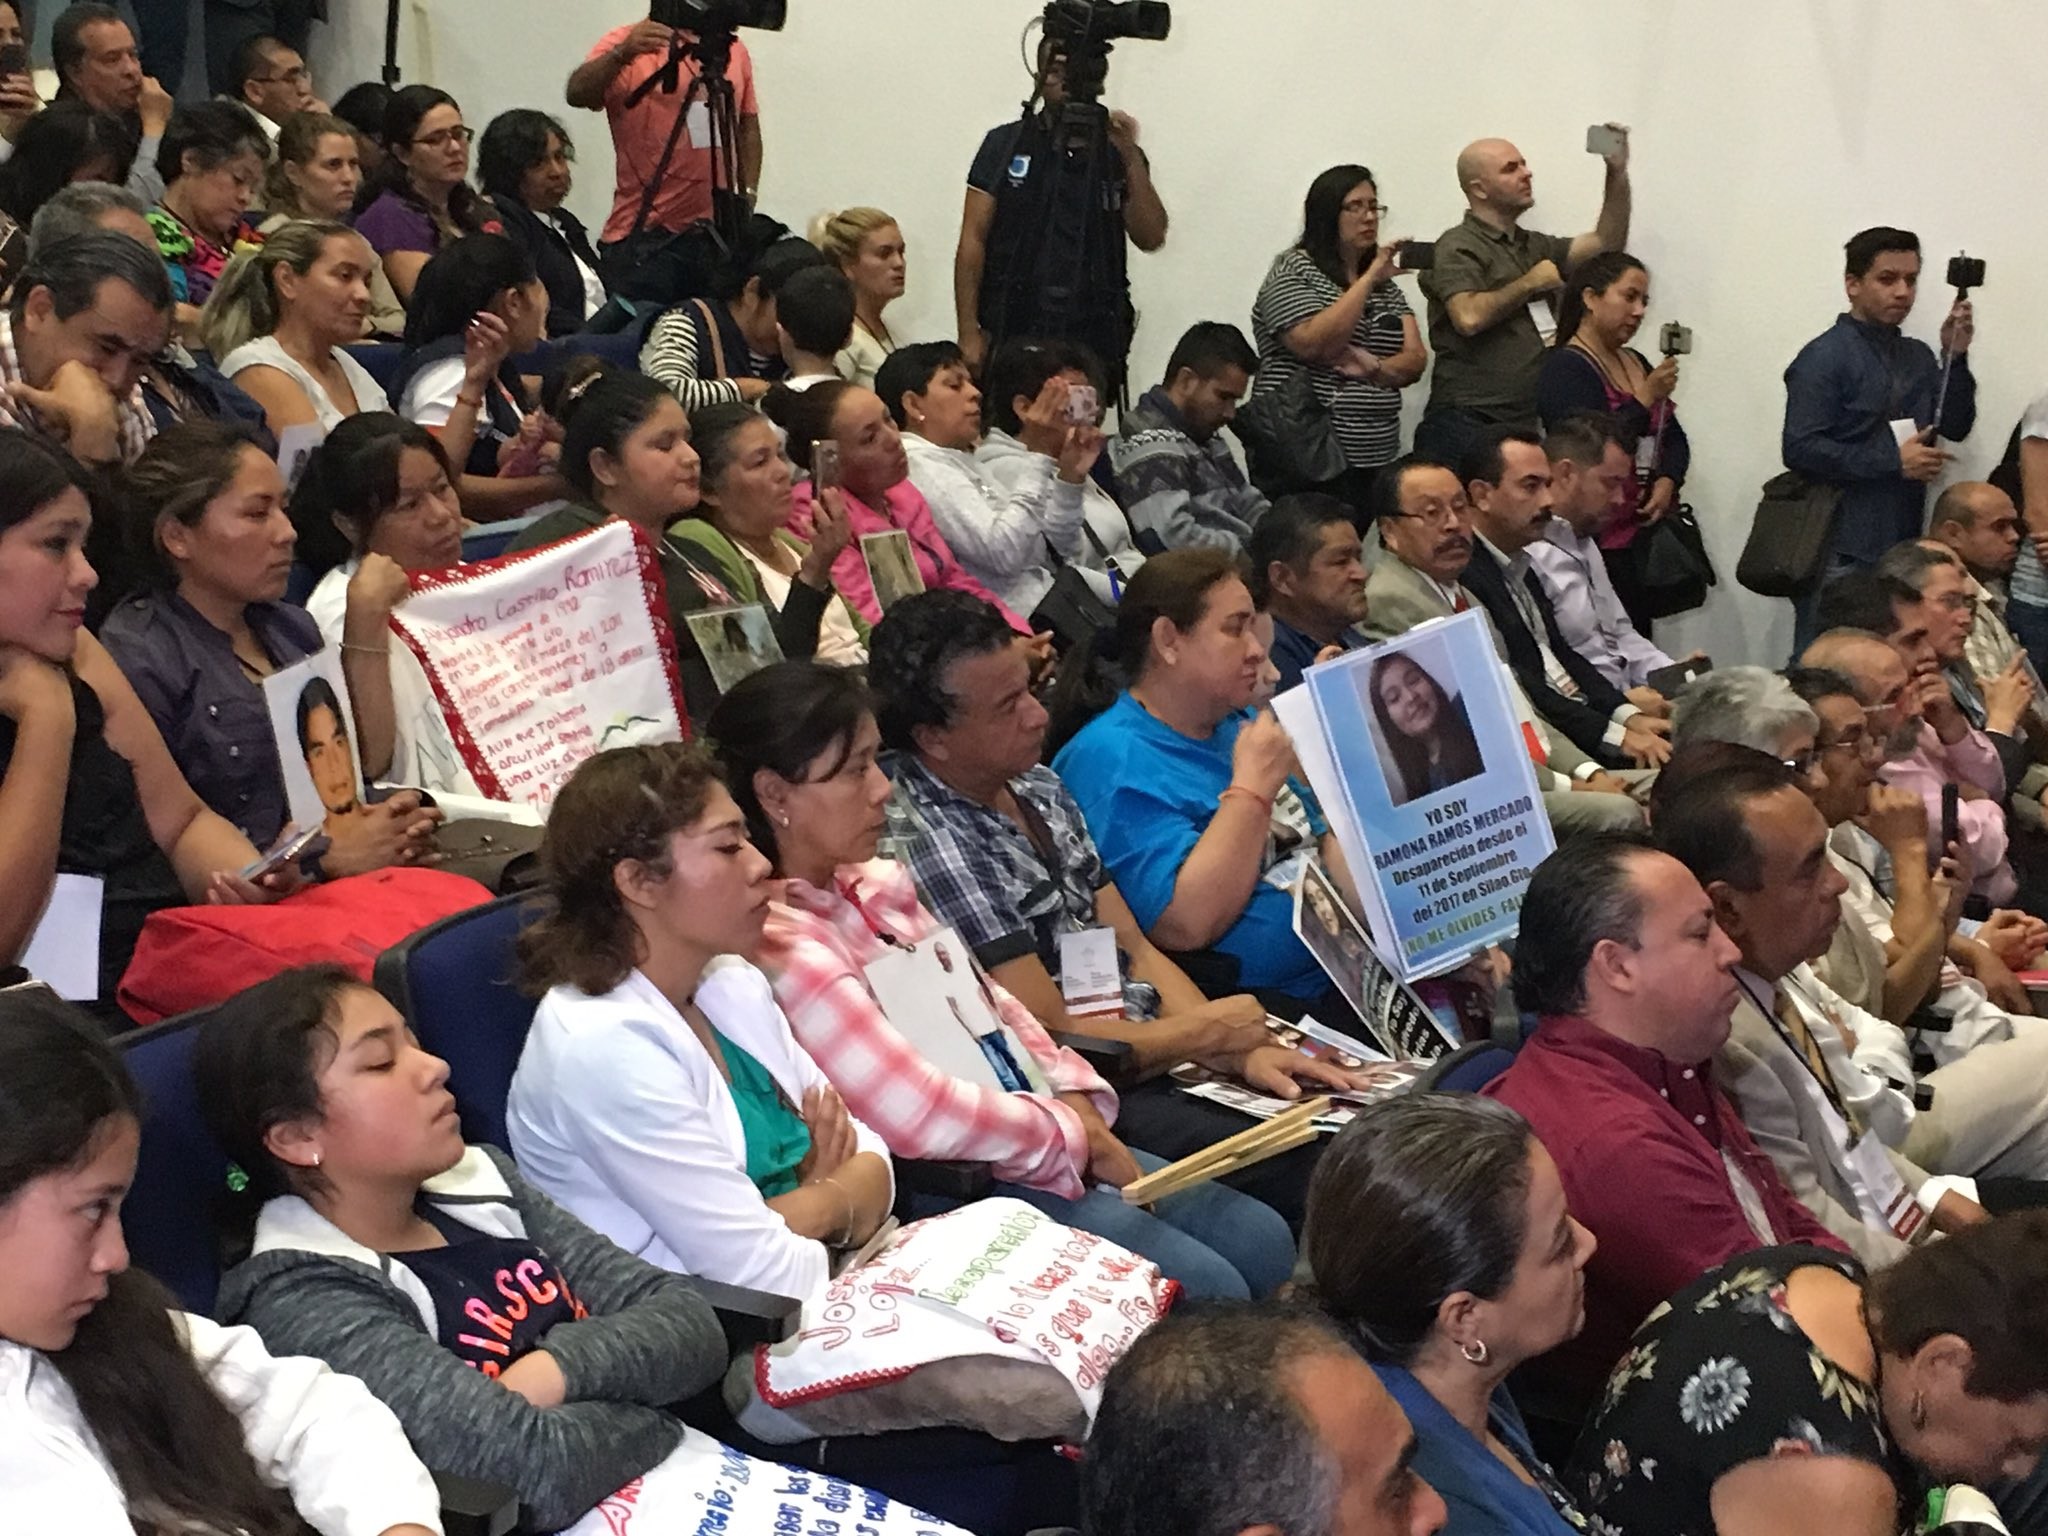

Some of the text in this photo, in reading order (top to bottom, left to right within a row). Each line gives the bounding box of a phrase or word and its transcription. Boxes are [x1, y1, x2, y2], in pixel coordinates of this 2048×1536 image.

[1374, 796, 1534, 871] RAMONA RAMOS MERCADO
[1425, 798, 1469, 827] YO SOY
[1392, 821, 1529, 887] Desaparecida desde el
[1431, 876, 1448, 894] de
[1449, 849, 1518, 887] Septiembre
[1412, 903, 1434, 924] del
[1433, 893, 1461, 916] 2017
[1462, 888, 1479, 903] en
[1427, 926, 1445, 945] ME
[1446, 905, 1497, 937] OLVIDES
